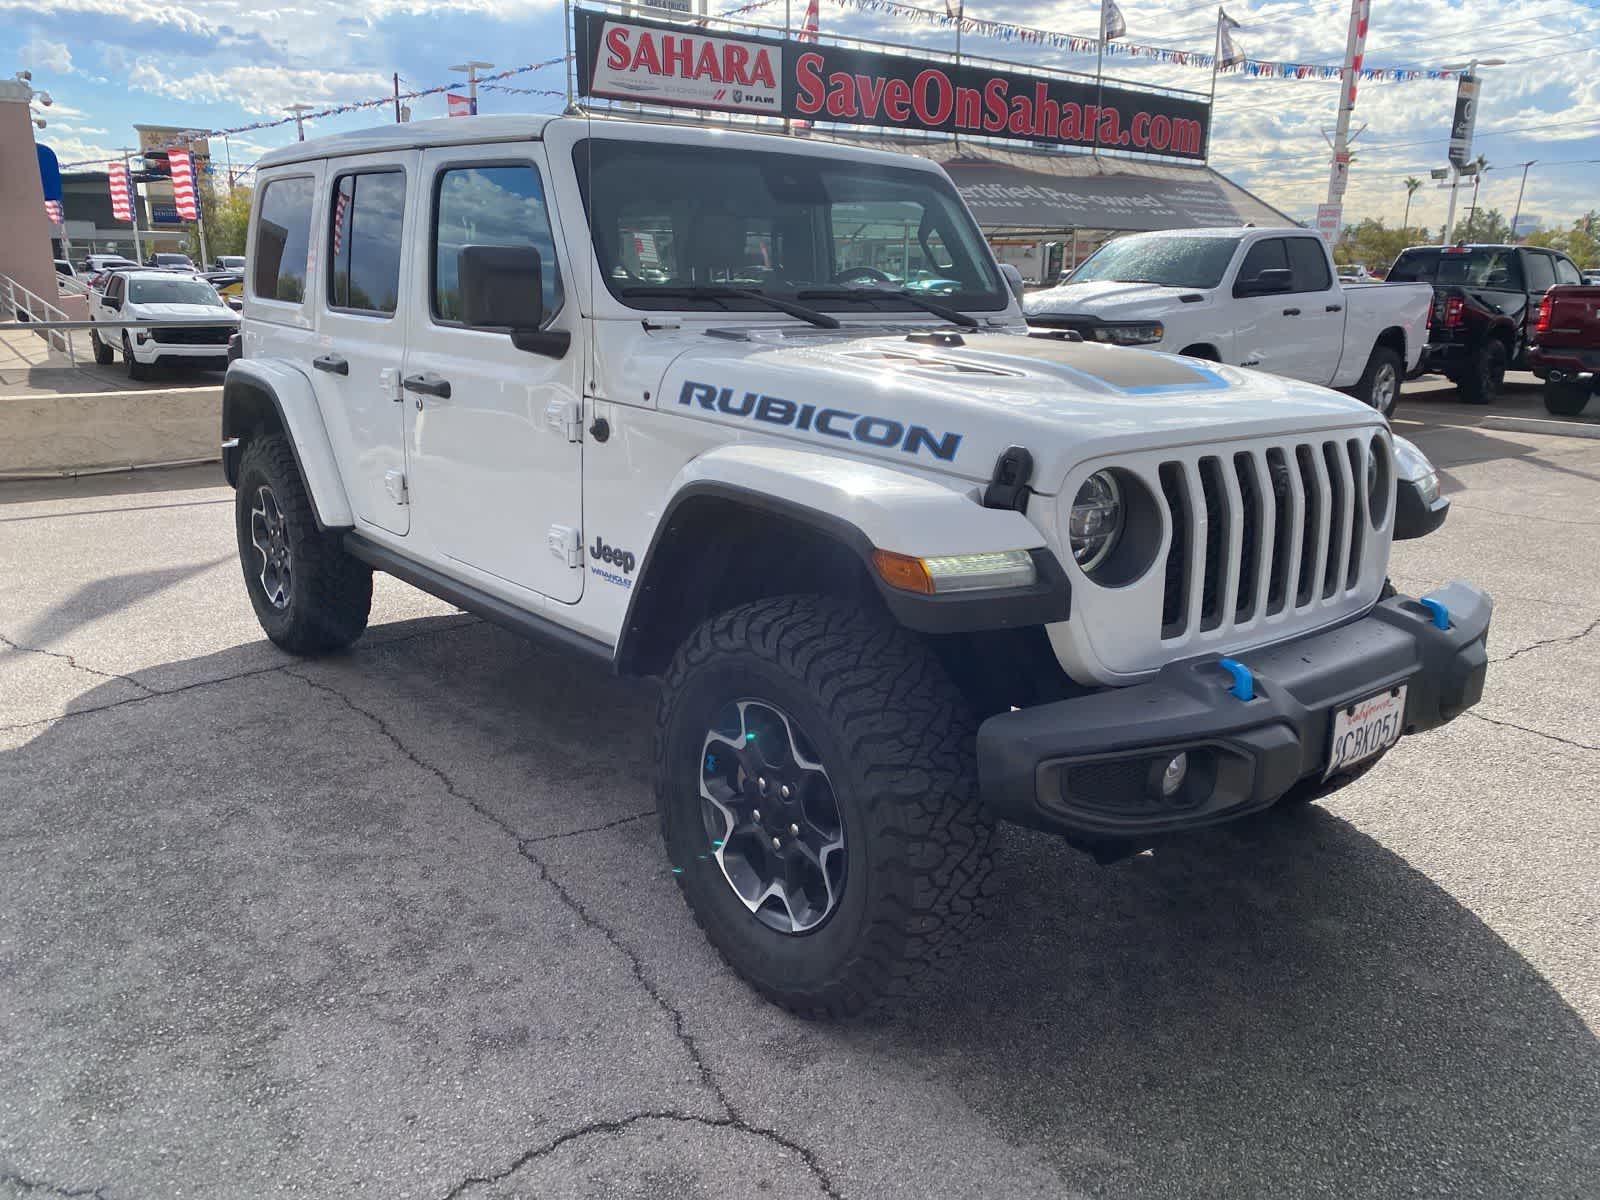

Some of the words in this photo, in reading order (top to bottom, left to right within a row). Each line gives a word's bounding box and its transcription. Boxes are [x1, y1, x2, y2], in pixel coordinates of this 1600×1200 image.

[606, 27, 776, 88] SAHARA
[745, 94, 775, 104] RAM
[796, 52, 1201, 154] SaveOnSahara.com
[958, 183, 1046, 200] ertified
[678, 380, 963, 462] RUBICON
[590, 535, 636, 575] Jeep
